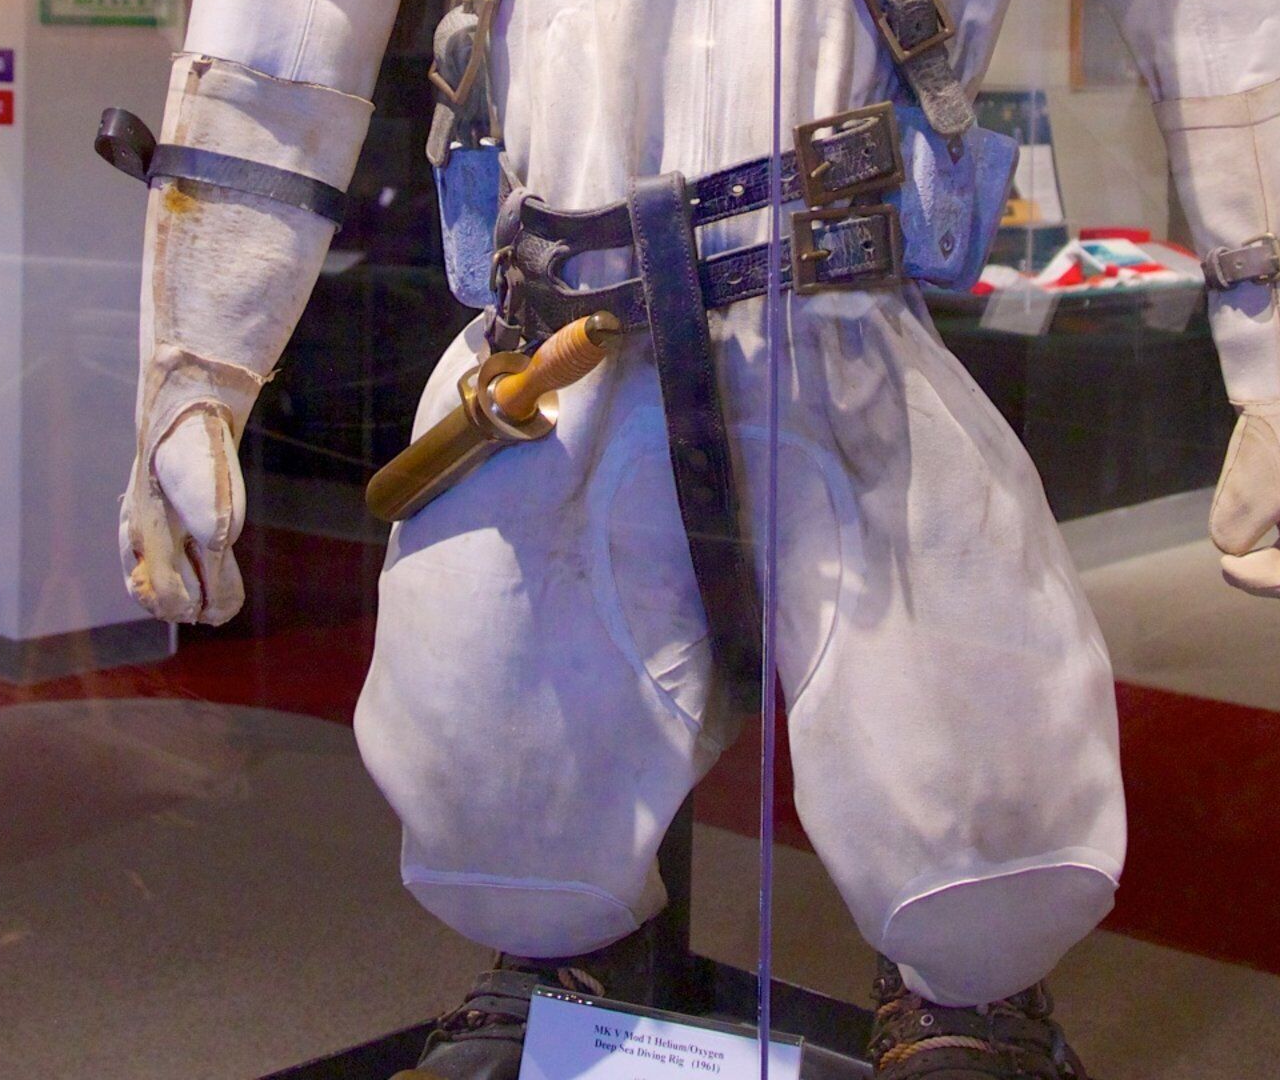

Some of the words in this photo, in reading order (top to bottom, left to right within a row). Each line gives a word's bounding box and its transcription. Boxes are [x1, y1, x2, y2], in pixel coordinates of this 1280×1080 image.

[594, 1024, 612, 1037] MK
[614, 1028, 622, 1038] V
[623, 1030, 645, 1044] Mod
[654, 1036, 725, 1060] Helium/Oxygen
[594, 1038, 618, 1054] Deep
[619, 1043, 635, 1056] Sea
[636, 1047, 667, 1064] Diving
[668, 1053, 685, 1068] Rig
[691, 1058, 721, 1075] (1961)
